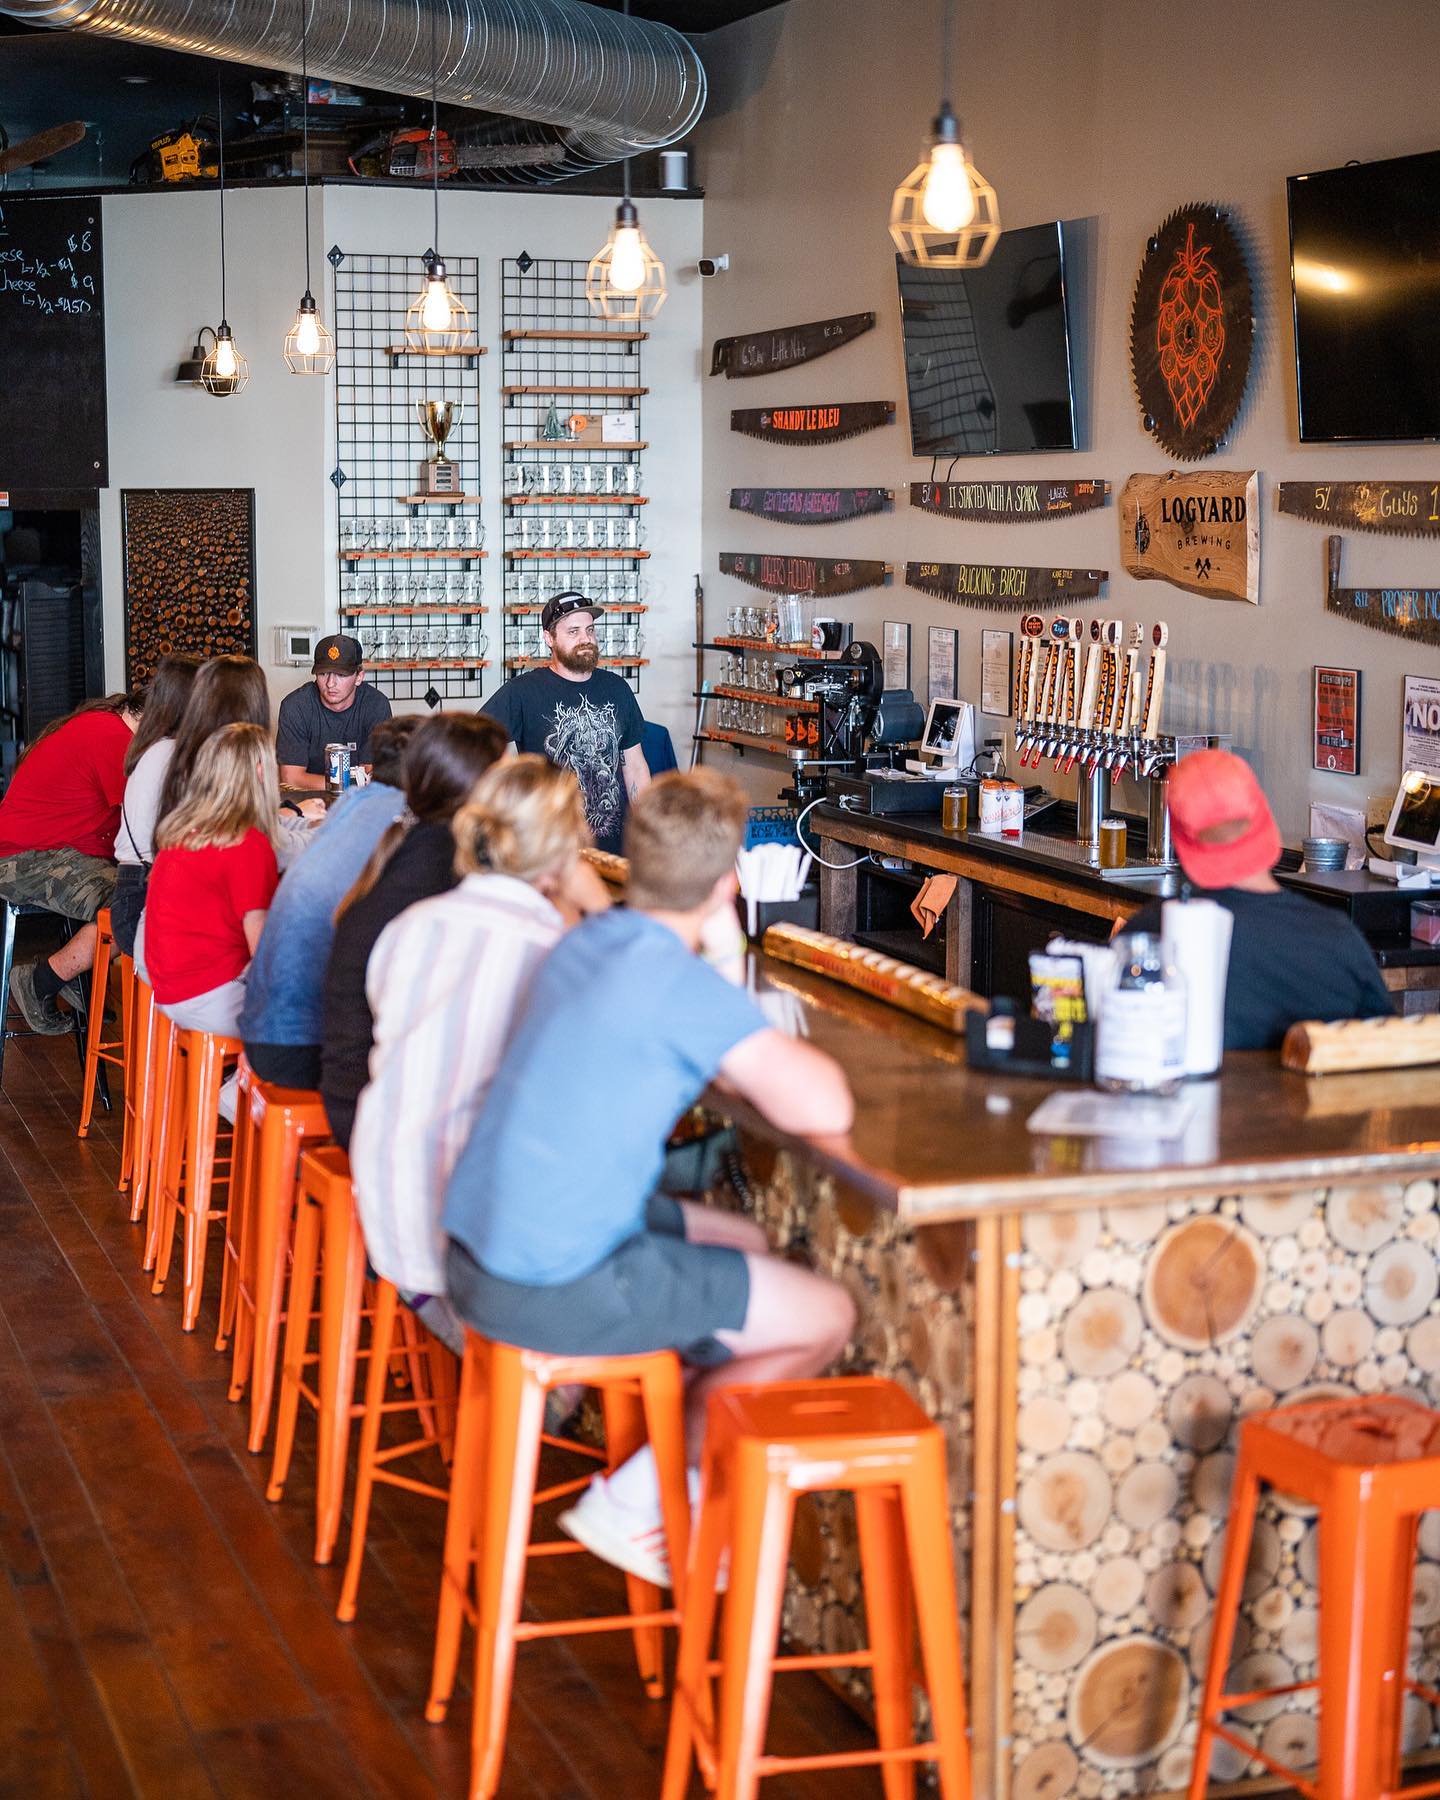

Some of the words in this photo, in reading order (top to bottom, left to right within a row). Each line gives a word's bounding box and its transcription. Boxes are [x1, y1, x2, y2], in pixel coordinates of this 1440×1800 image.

[0, 269, 36, 291] heese
[773, 410, 805, 430] SHANDY
[806, 410, 817, 430] LE
[818, 408, 840, 429] BLEU
[949, 486, 957, 509] IT
[959, 484, 985, 509] STARTED
[985, 484, 1004, 511] WITH
[1006, 486, 1013, 512] A
[1015, 485, 1041, 512] SPARK
[1161, 496, 1246, 523] LOGYARD
[1315, 486, 1331, 511] 5%
[1380, 490, 1419, 518] Guys
[1429, 485, 1440, 520] 1
[1177, 535, 1231, 550] BREWING
[958, 565, 995, 595] BUCKING
[1000, 568, 1027, 597] BIRCH
[1066, 649, 1074, 719] LOGYARD
[1104, 654, 1115, 726] LOGYARD
[1116, 656, 1130, 728] LOGYARD
